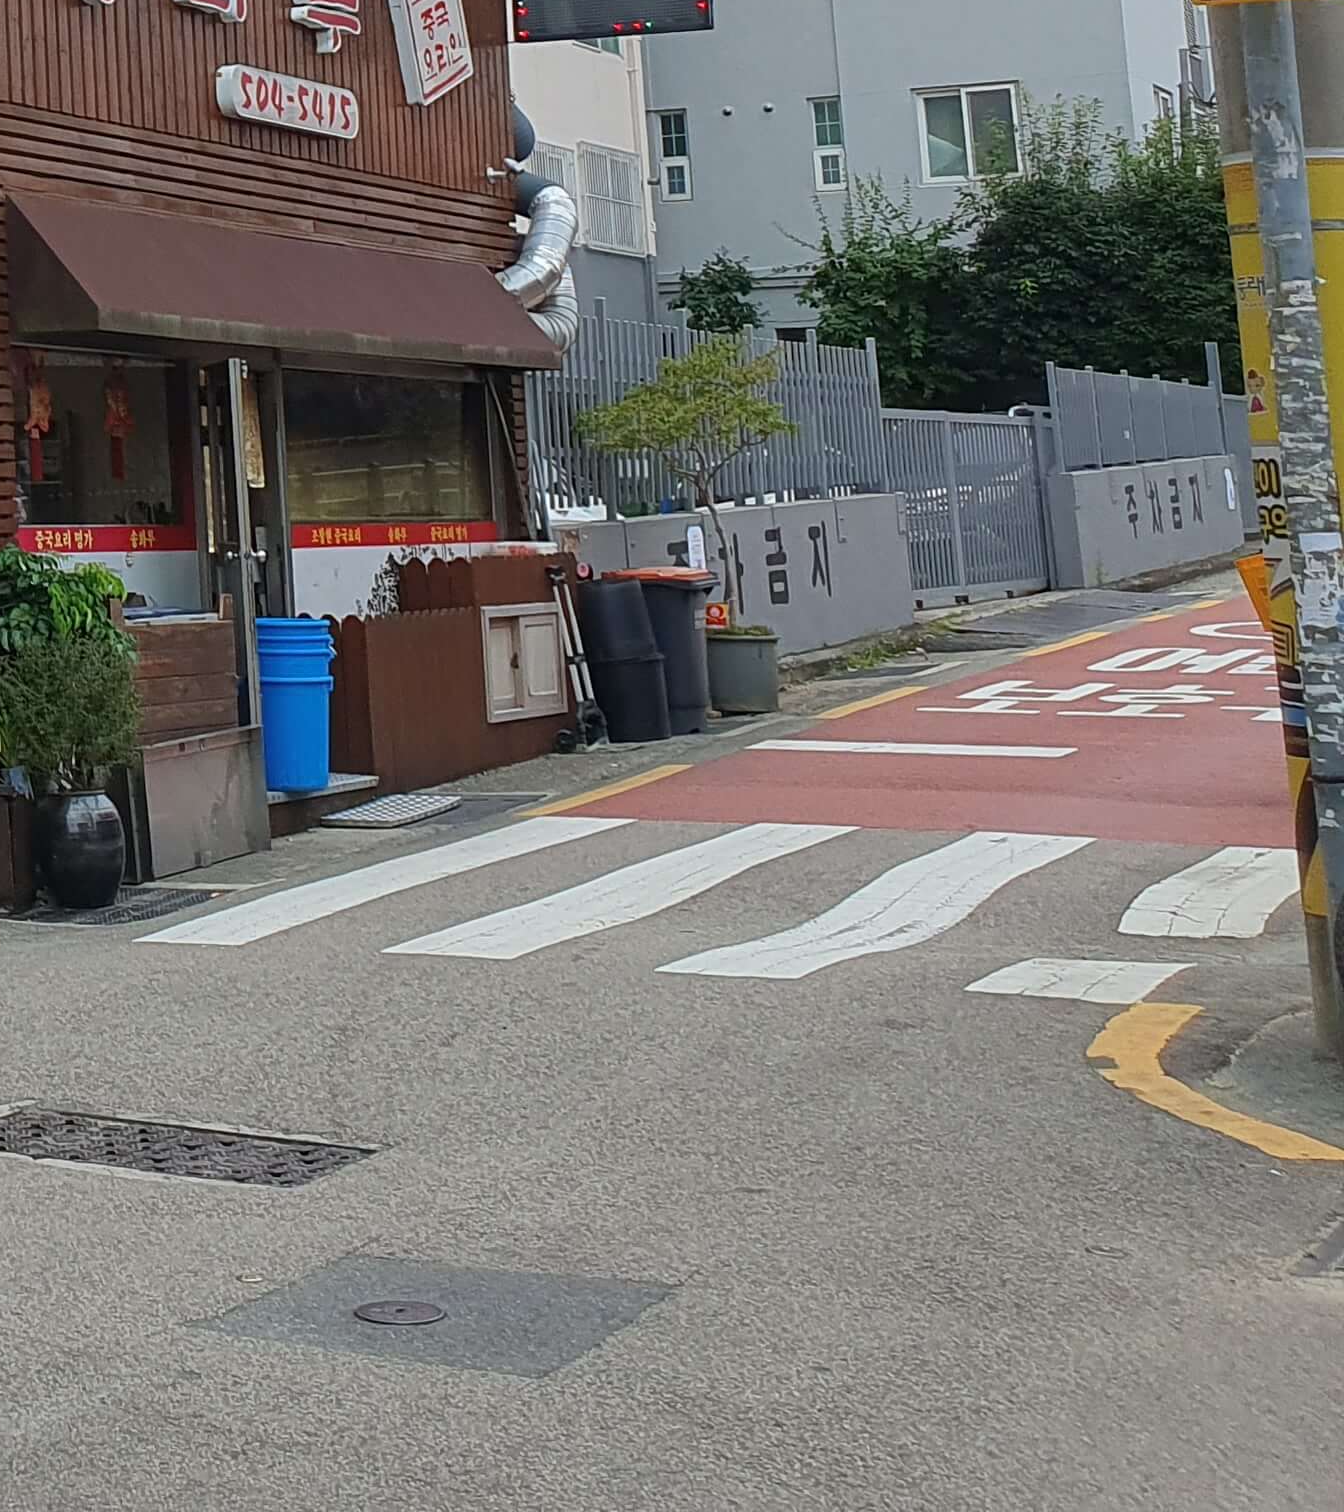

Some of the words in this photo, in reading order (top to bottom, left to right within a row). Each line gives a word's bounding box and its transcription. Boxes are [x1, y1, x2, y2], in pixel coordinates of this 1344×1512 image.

[420, 0, 450, 40] 중국
[423, 32, 464, 82] 요리인
[239, 70, 354, 133] 504-5415
[1124, 473, 1204, 540] 주차금지
[34, 529, 72, 550] 중국요리
[74, 529, 94, 550] 명가
